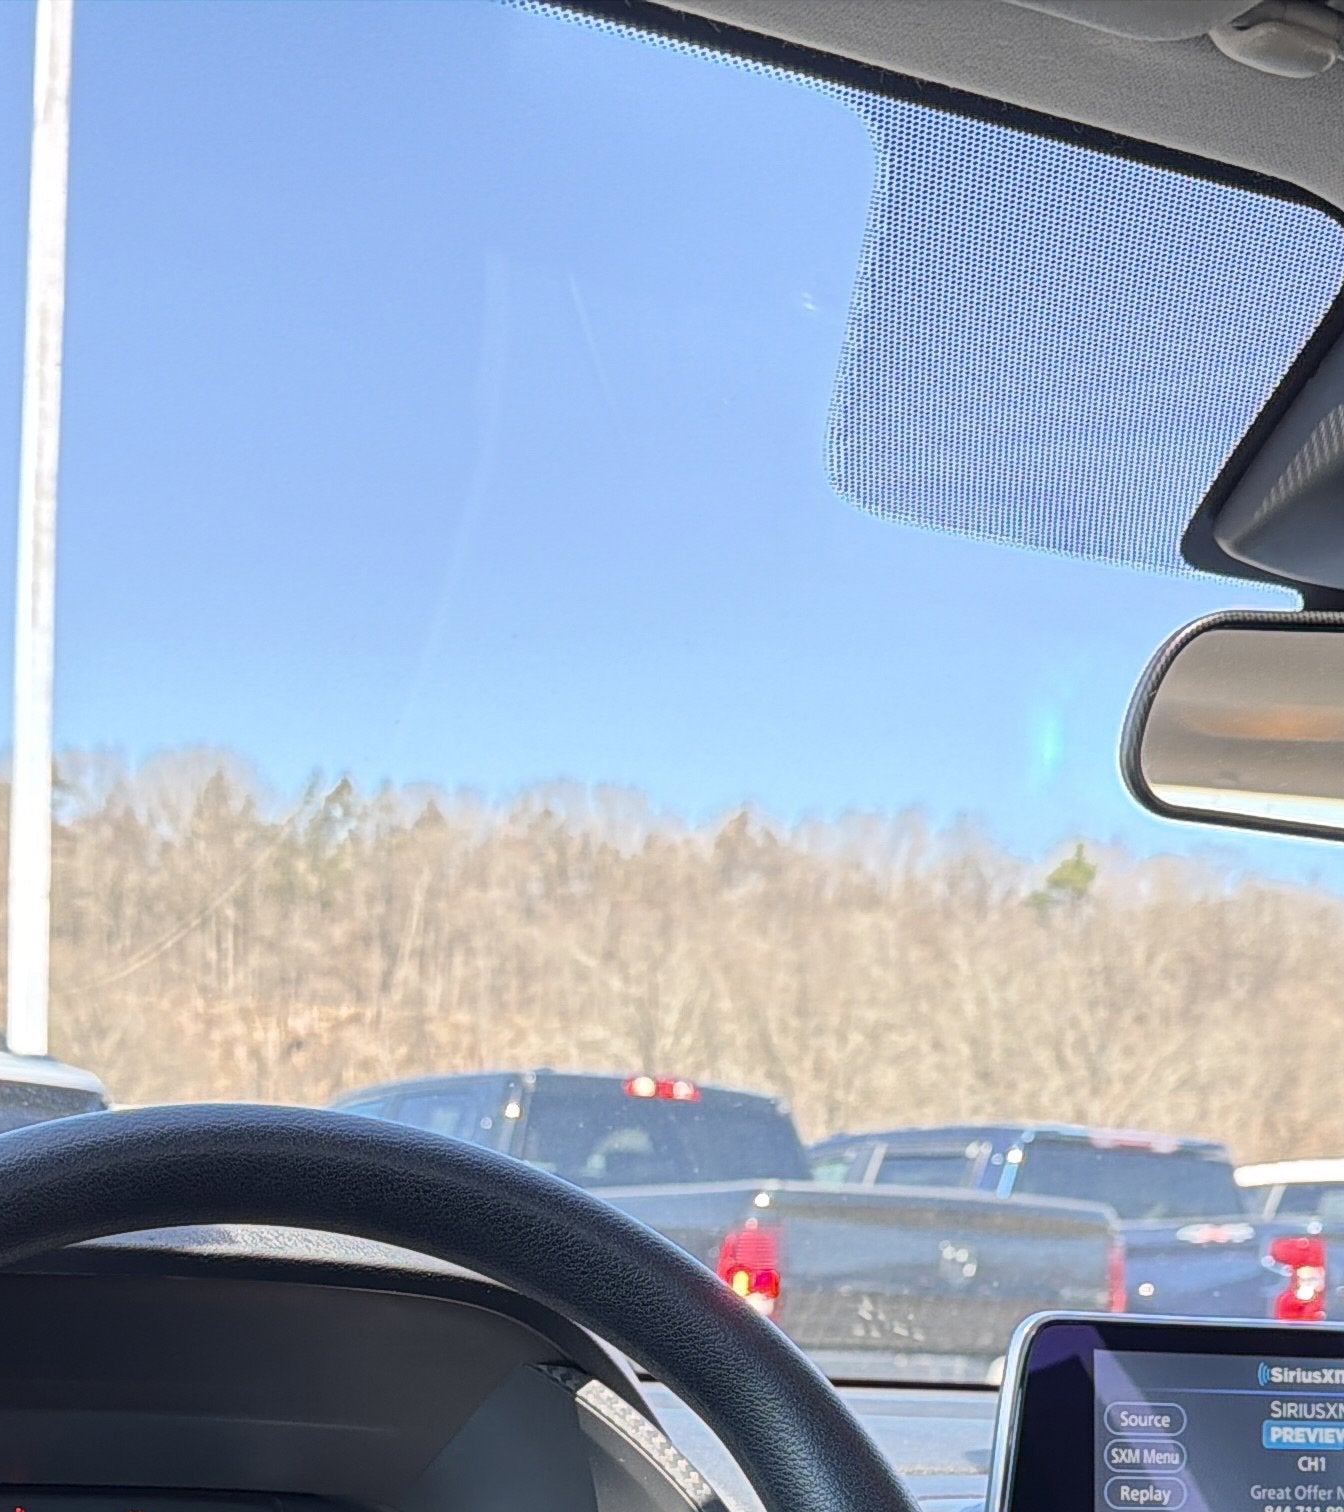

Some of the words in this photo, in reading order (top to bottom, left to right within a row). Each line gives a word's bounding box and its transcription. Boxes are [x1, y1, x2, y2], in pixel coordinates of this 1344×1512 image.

[1120, 1411, 1171, 1428] Source
[1111, 1449, 1140, 1465] SXM
[1143, 1449, 1180, 1465] Menu
[1297, 1456, 1327, 1472] CH1
[1120, 1485, 1172, 1505] Replay
[1250, 1485, 1291, 1500] Great
[1295, 1485, 1332, 1501] Offer
